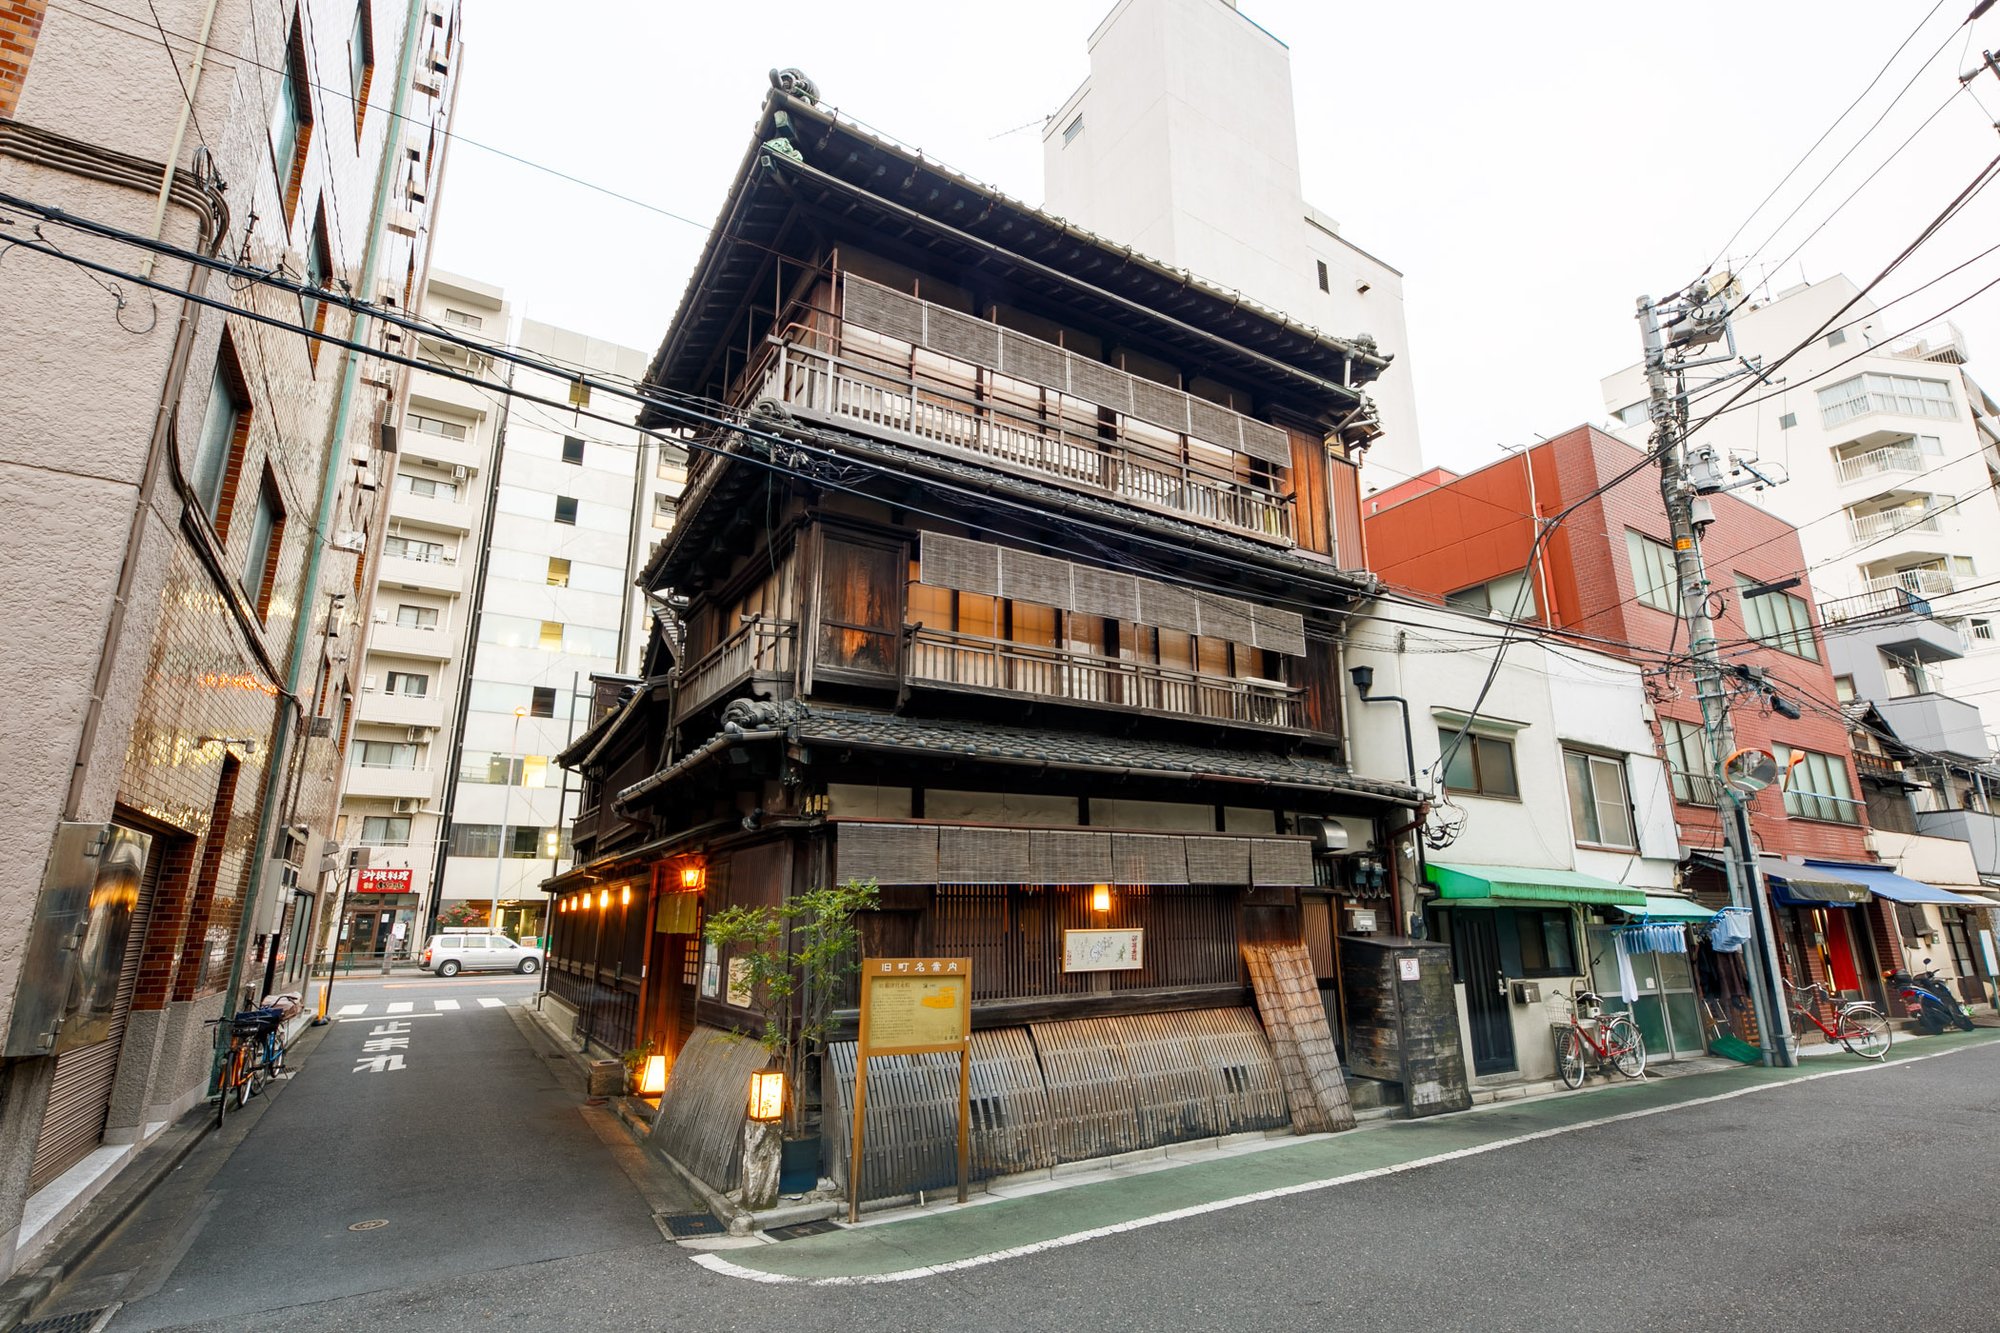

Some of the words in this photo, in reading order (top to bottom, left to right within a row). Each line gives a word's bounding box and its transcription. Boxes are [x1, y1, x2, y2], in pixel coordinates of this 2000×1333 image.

[881, 962, 958, 972] 旧町名案内
[352, 1021, 411, 1073] 止まれ
